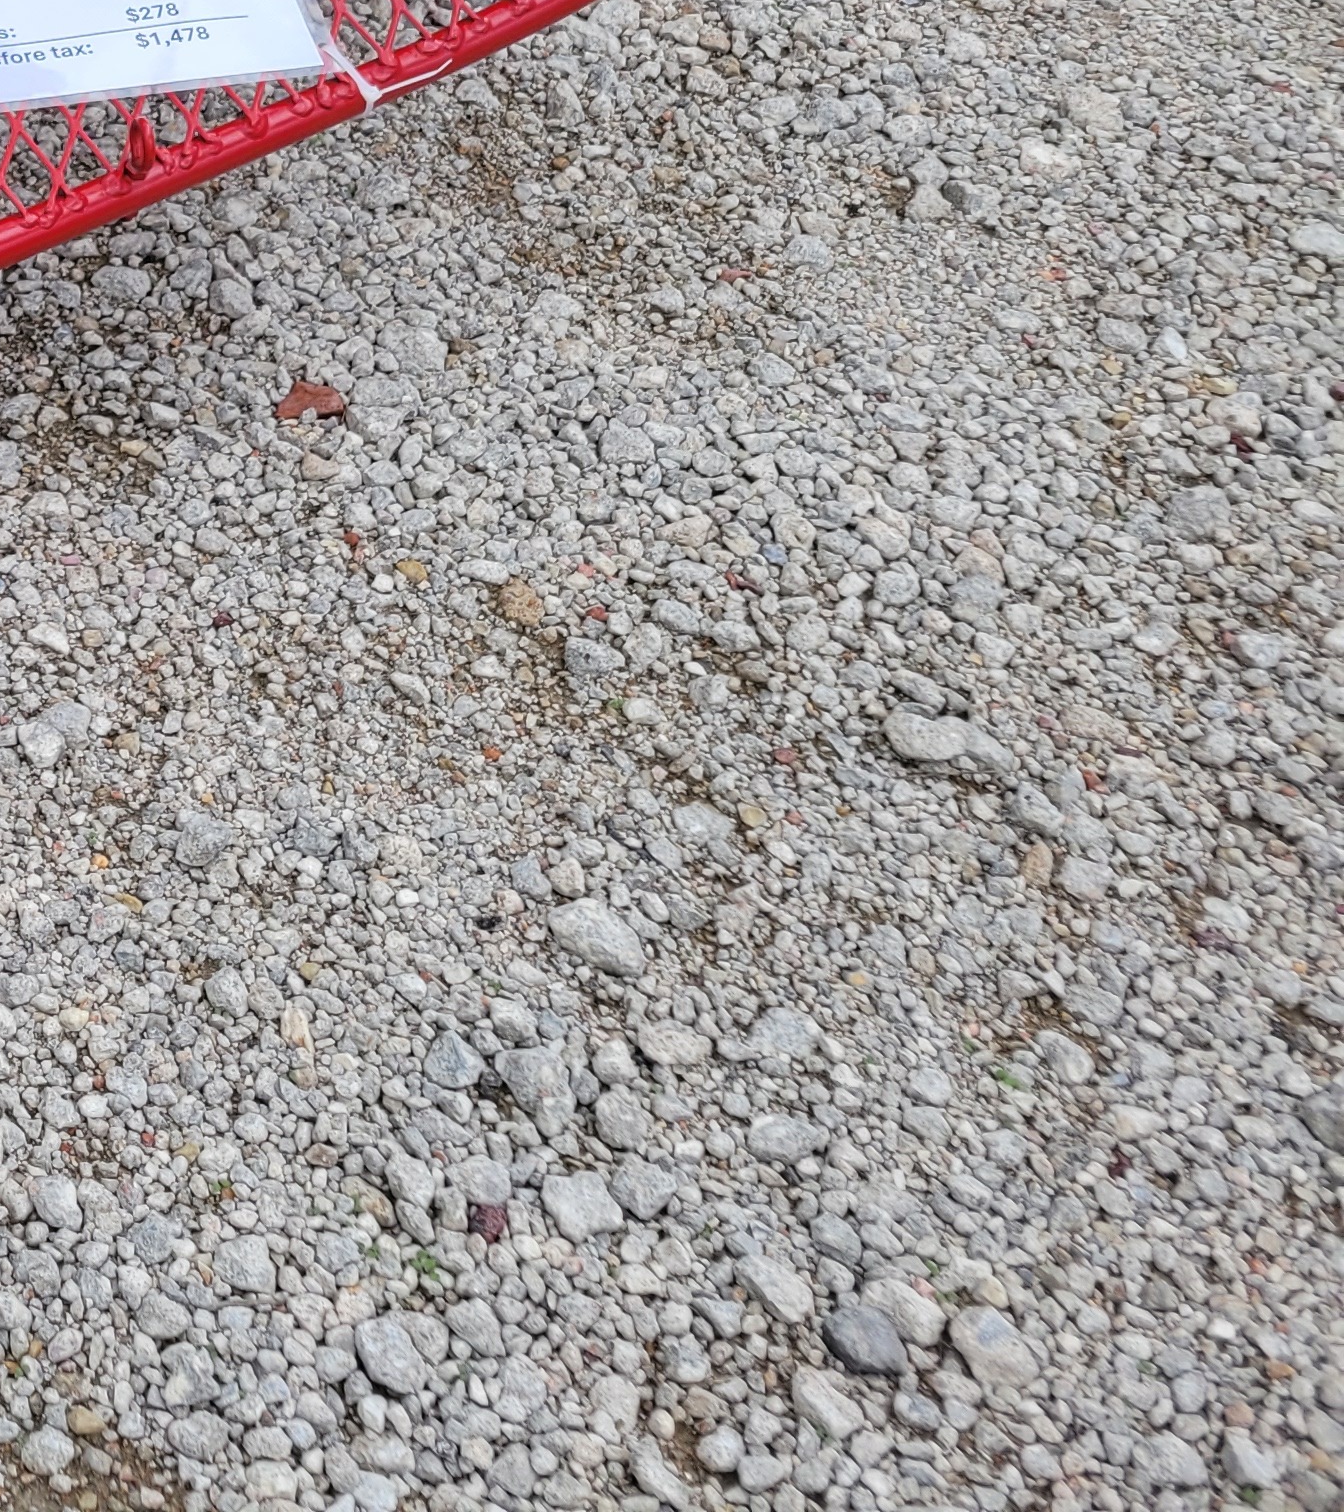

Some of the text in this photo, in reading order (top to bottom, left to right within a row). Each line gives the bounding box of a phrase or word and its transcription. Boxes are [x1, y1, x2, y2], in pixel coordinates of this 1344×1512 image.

[124, 2, 180, 23] $278
[49, 41, 95, 59] tax:
[134, 26, 210, 49] $1,478
